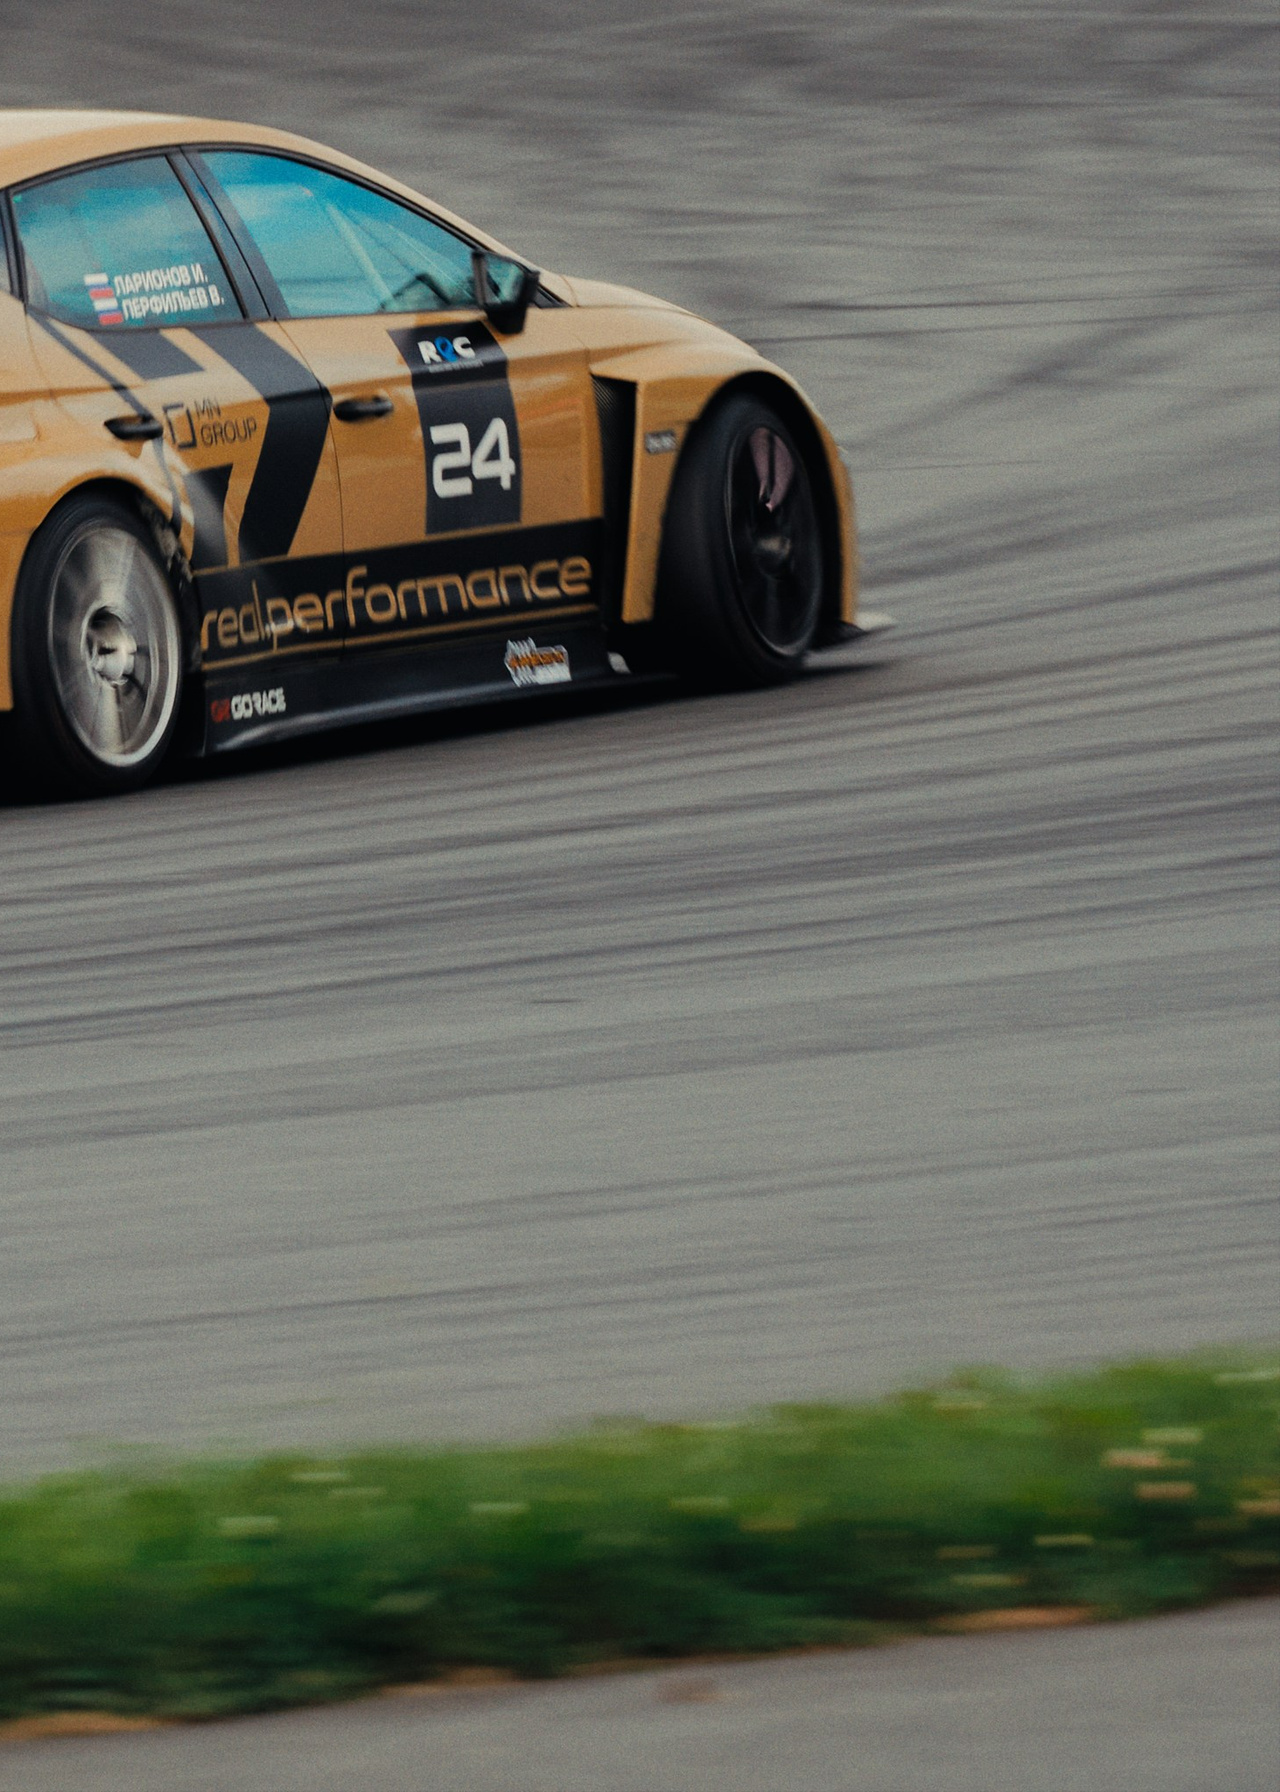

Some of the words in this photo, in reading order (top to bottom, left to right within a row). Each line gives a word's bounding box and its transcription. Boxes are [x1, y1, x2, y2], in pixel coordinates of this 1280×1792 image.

[114, 265, 191, 297] ЛАРИОНОВ
[122, 286, 209, 321] ПЕРФИЛЬЕВ
[200, 416, 257, 447] GROUP
[429, 417, 516, 499] 24
